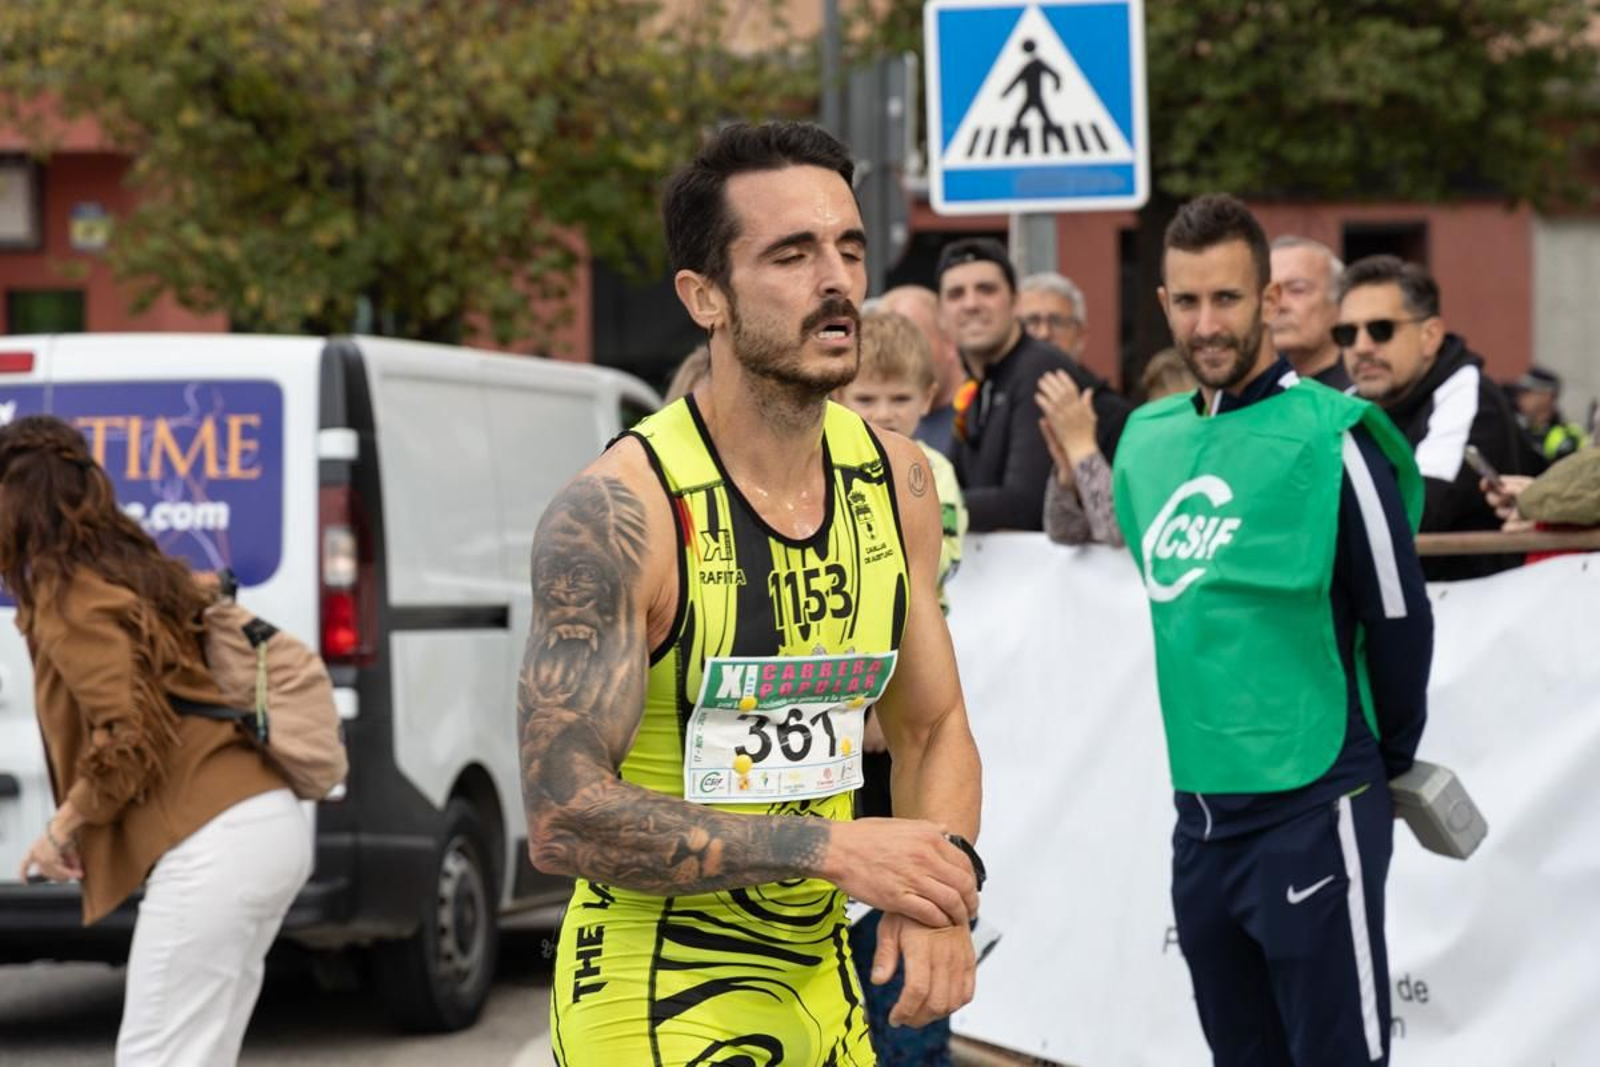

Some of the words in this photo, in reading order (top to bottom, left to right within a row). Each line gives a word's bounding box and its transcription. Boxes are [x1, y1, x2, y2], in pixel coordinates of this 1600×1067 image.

[699, 570, 747, 585] RAFITA
[768, 563, 853, 628] 1153
[762, 660, 882, 680] CARRERA
[759, 674, 876, 699] POPULAR
[734, 708, 837, 764] 361
[573, 925, 608, 1004] THE
[1397, 973, 1429, 1003] de
